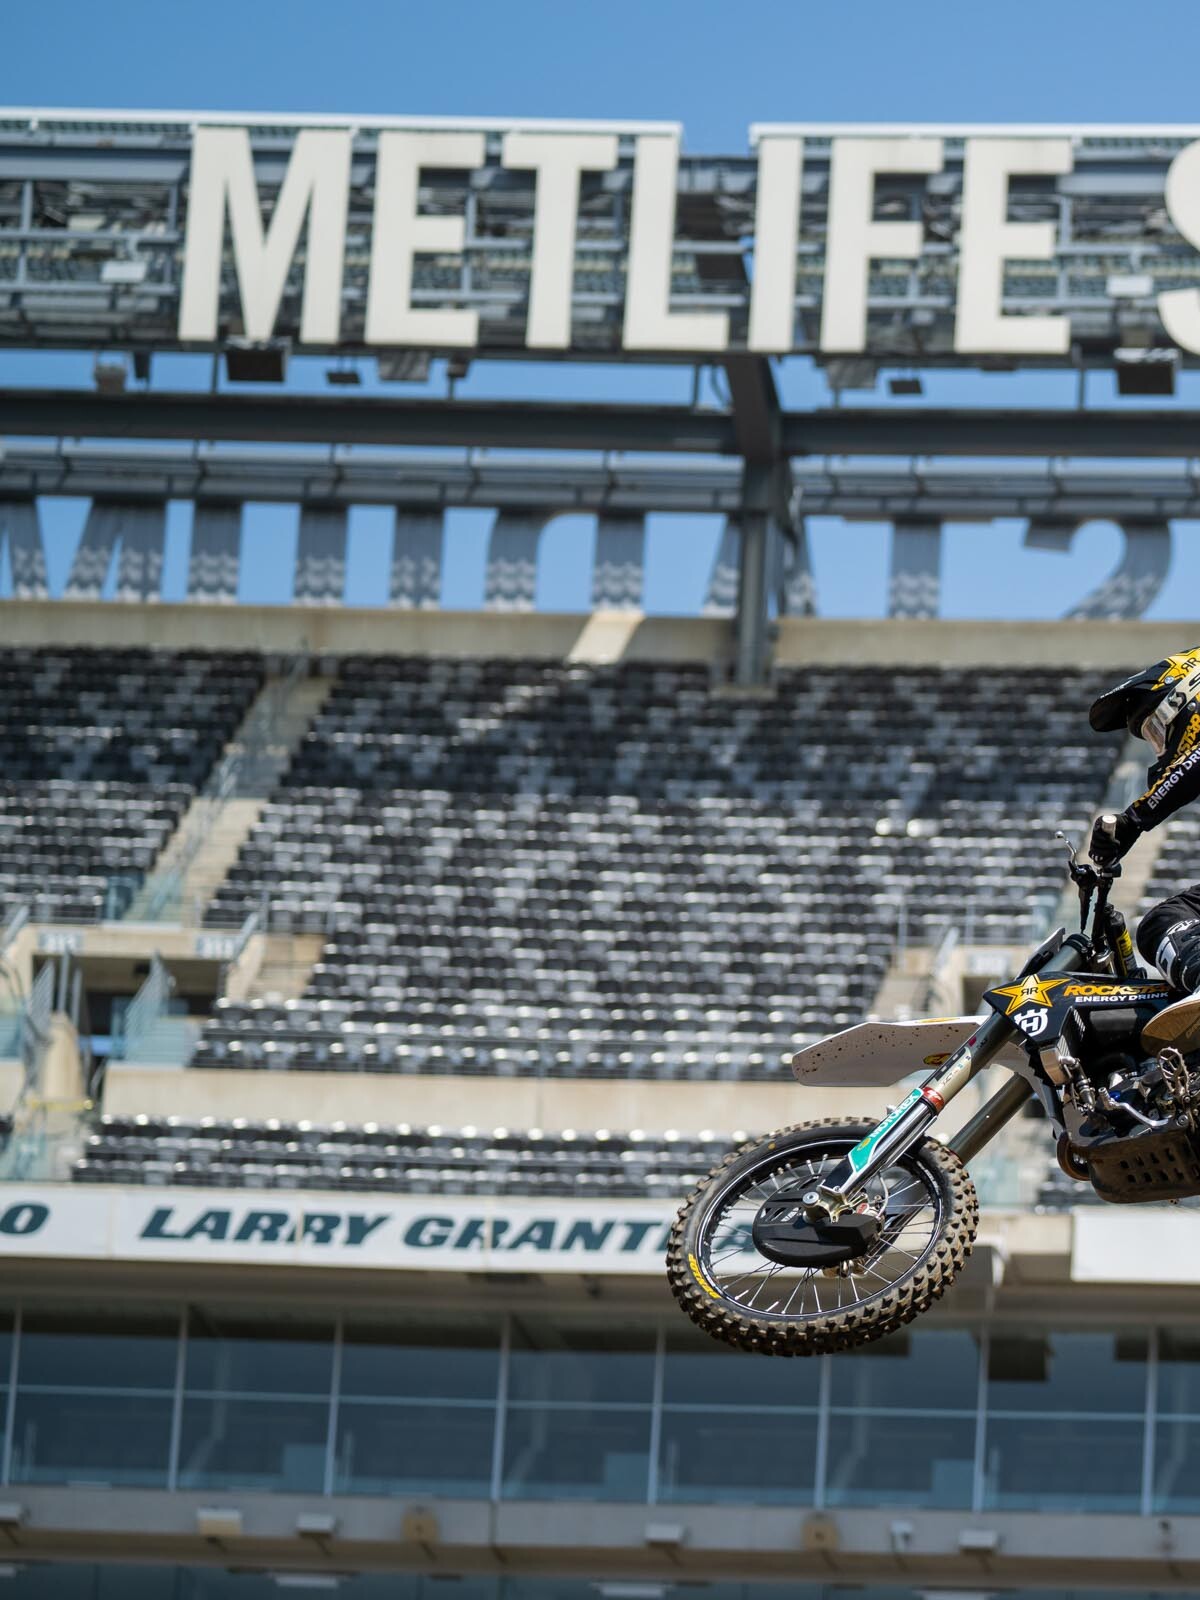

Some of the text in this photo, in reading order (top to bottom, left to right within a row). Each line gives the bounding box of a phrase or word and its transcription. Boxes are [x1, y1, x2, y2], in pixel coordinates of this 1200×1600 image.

[178, 126, 1074, 354] METLIFE
[1147, 769, 1185, 810] ENERGY
[1130, 991, 1169, 1002] DRINK
[869, 1092, 922, 1139] MOTOREX
[139, 1208, 391, 1246] LARRY
